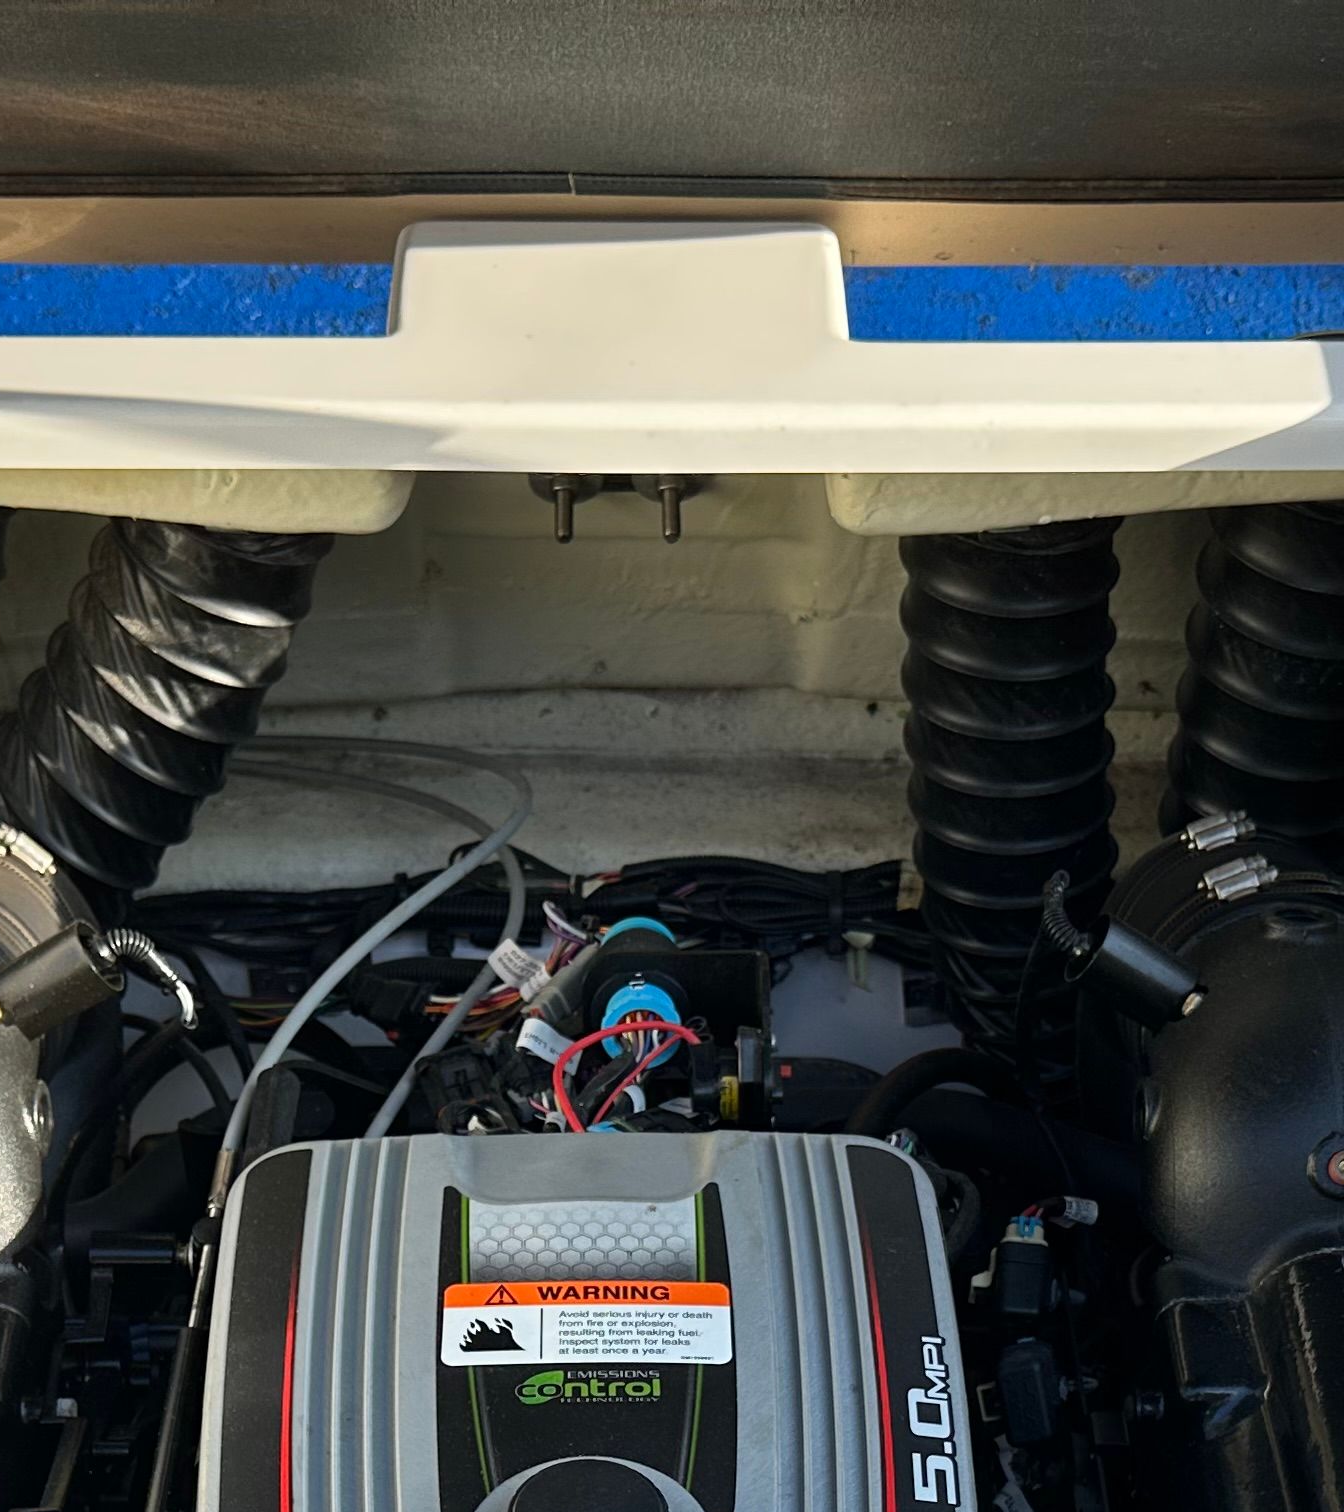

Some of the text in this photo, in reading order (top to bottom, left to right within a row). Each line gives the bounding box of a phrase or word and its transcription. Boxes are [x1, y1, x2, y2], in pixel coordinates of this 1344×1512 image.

[538, 1286, 670, 1301] WARNING
[559, 1311, 589, 1319] Avoid
[635, 1311, 664, 1320] injury
[559, 1329, 604, 1337] resulting
[636, 1329, 675, 1338] leaking
[559, 1338, 598, 1346] Inspect
[567, 1370, 660, 1379] EMISSIONS
[515, 1378, 662, 1398] control
